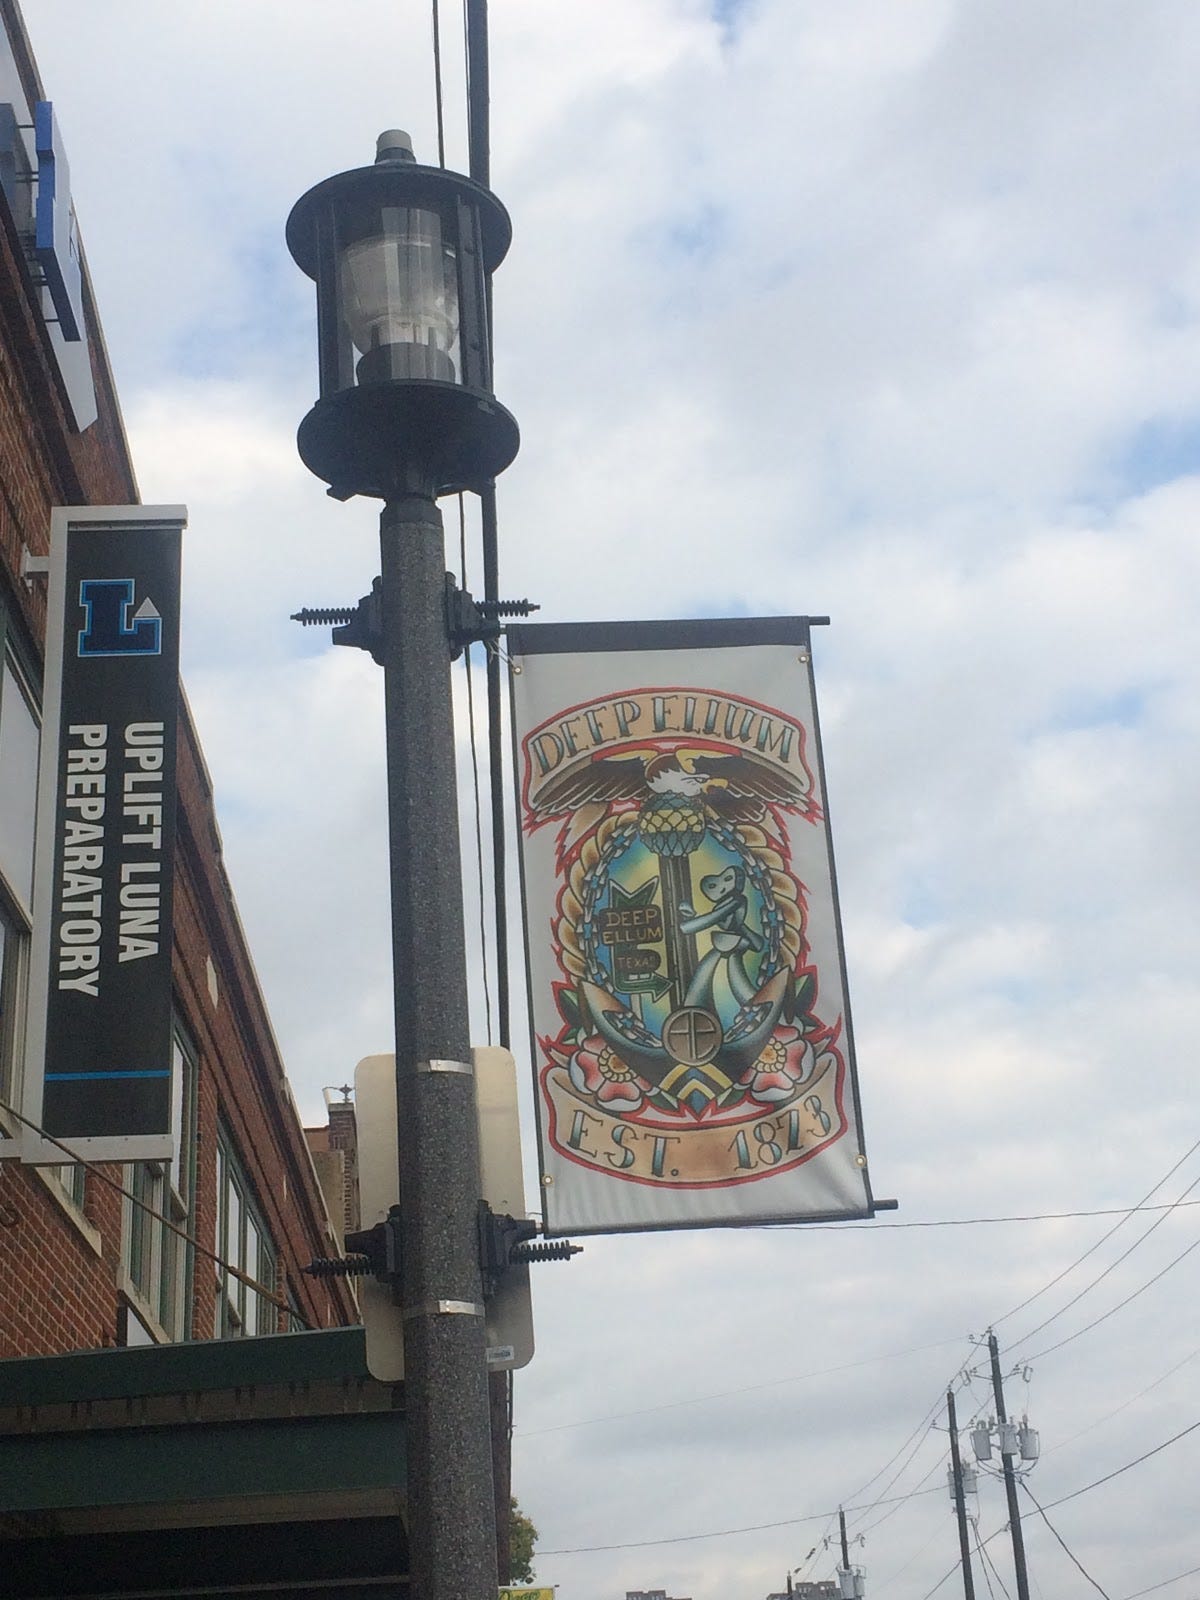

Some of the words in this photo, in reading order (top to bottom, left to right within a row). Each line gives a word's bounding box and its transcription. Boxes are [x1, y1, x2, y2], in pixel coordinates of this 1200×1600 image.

[78, 579, 162, 657] L
[531, 699, 641, 776] DEEP
[651, 696, 795, 763] ELLUM
[122, 722, 164, 850] UPLIFT
[58, 724, 108, 997] PREPARATORY
[118, 862, 160, 963] LUNA
[602, 927, 662, 944] ELLUM
[606, 908, 657, 927] DEEP
[566, 1109, 681, 1177] EST.
[728, 1095, 832, 1171] 1873
